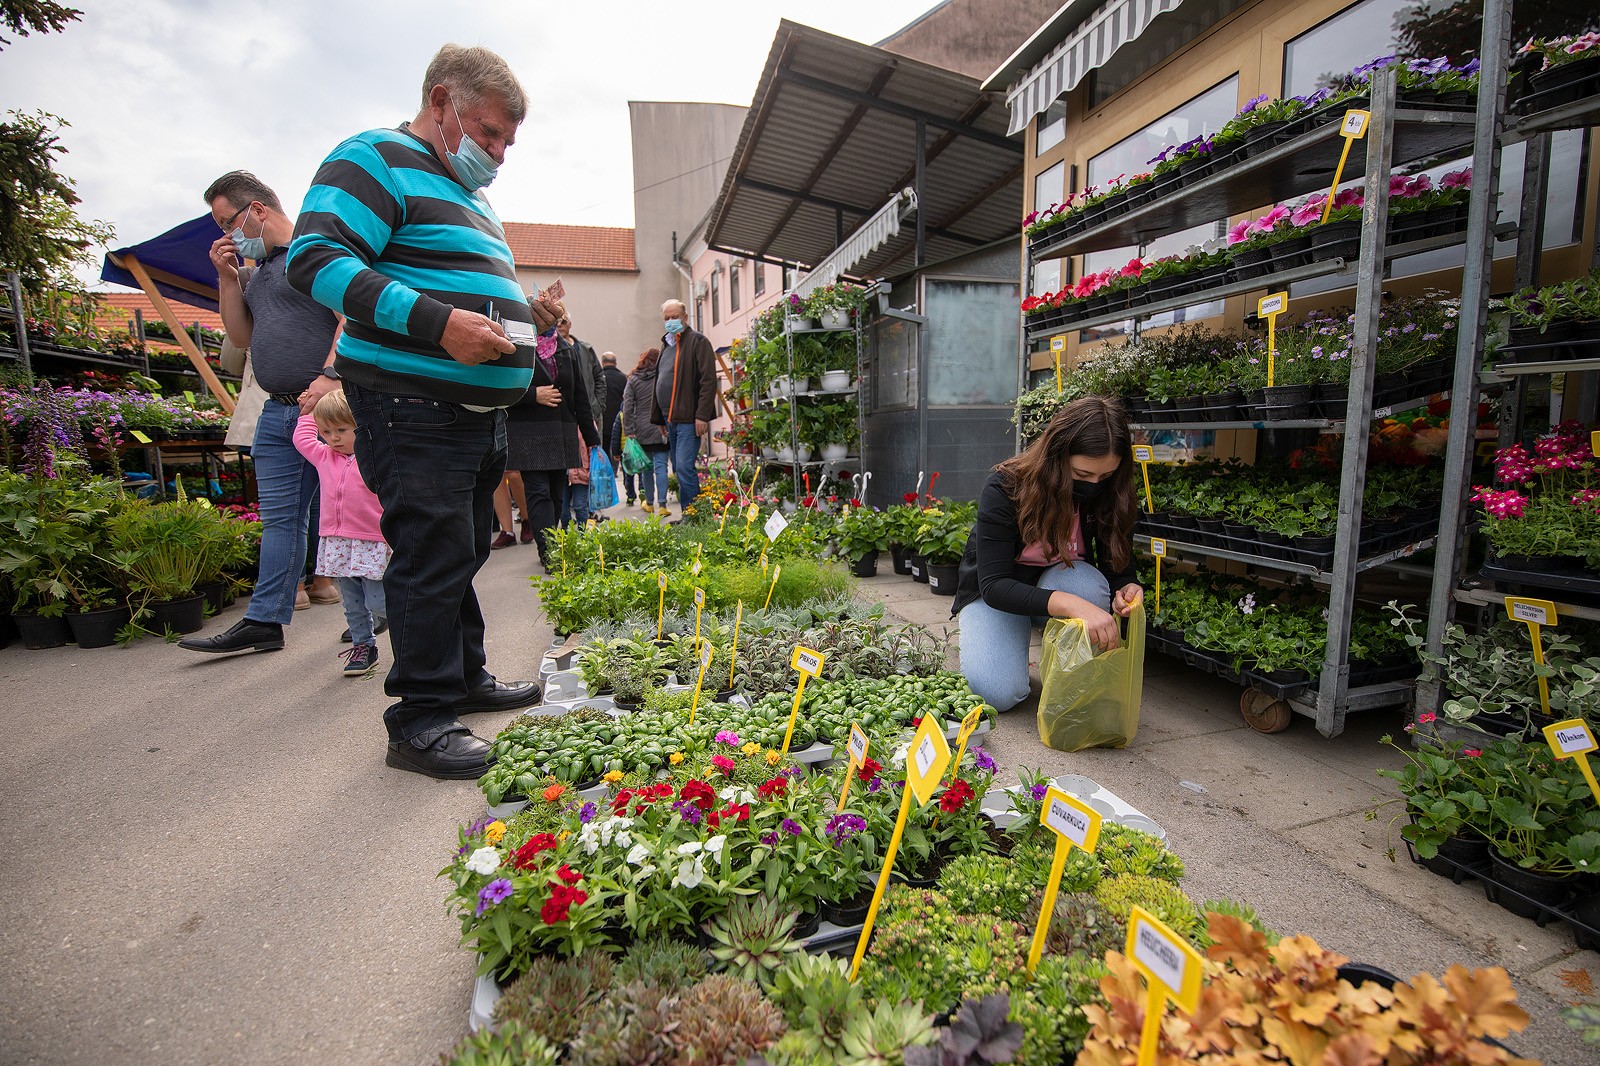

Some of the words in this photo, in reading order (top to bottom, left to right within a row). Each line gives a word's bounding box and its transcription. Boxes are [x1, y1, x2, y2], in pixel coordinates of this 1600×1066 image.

[1348, 116, 1356, 126] 4
[1521, 610, 1538, 618] SILVER
[799, 653, 818, 667] PRKOS
[1556, 732, 1568, 744] 10
